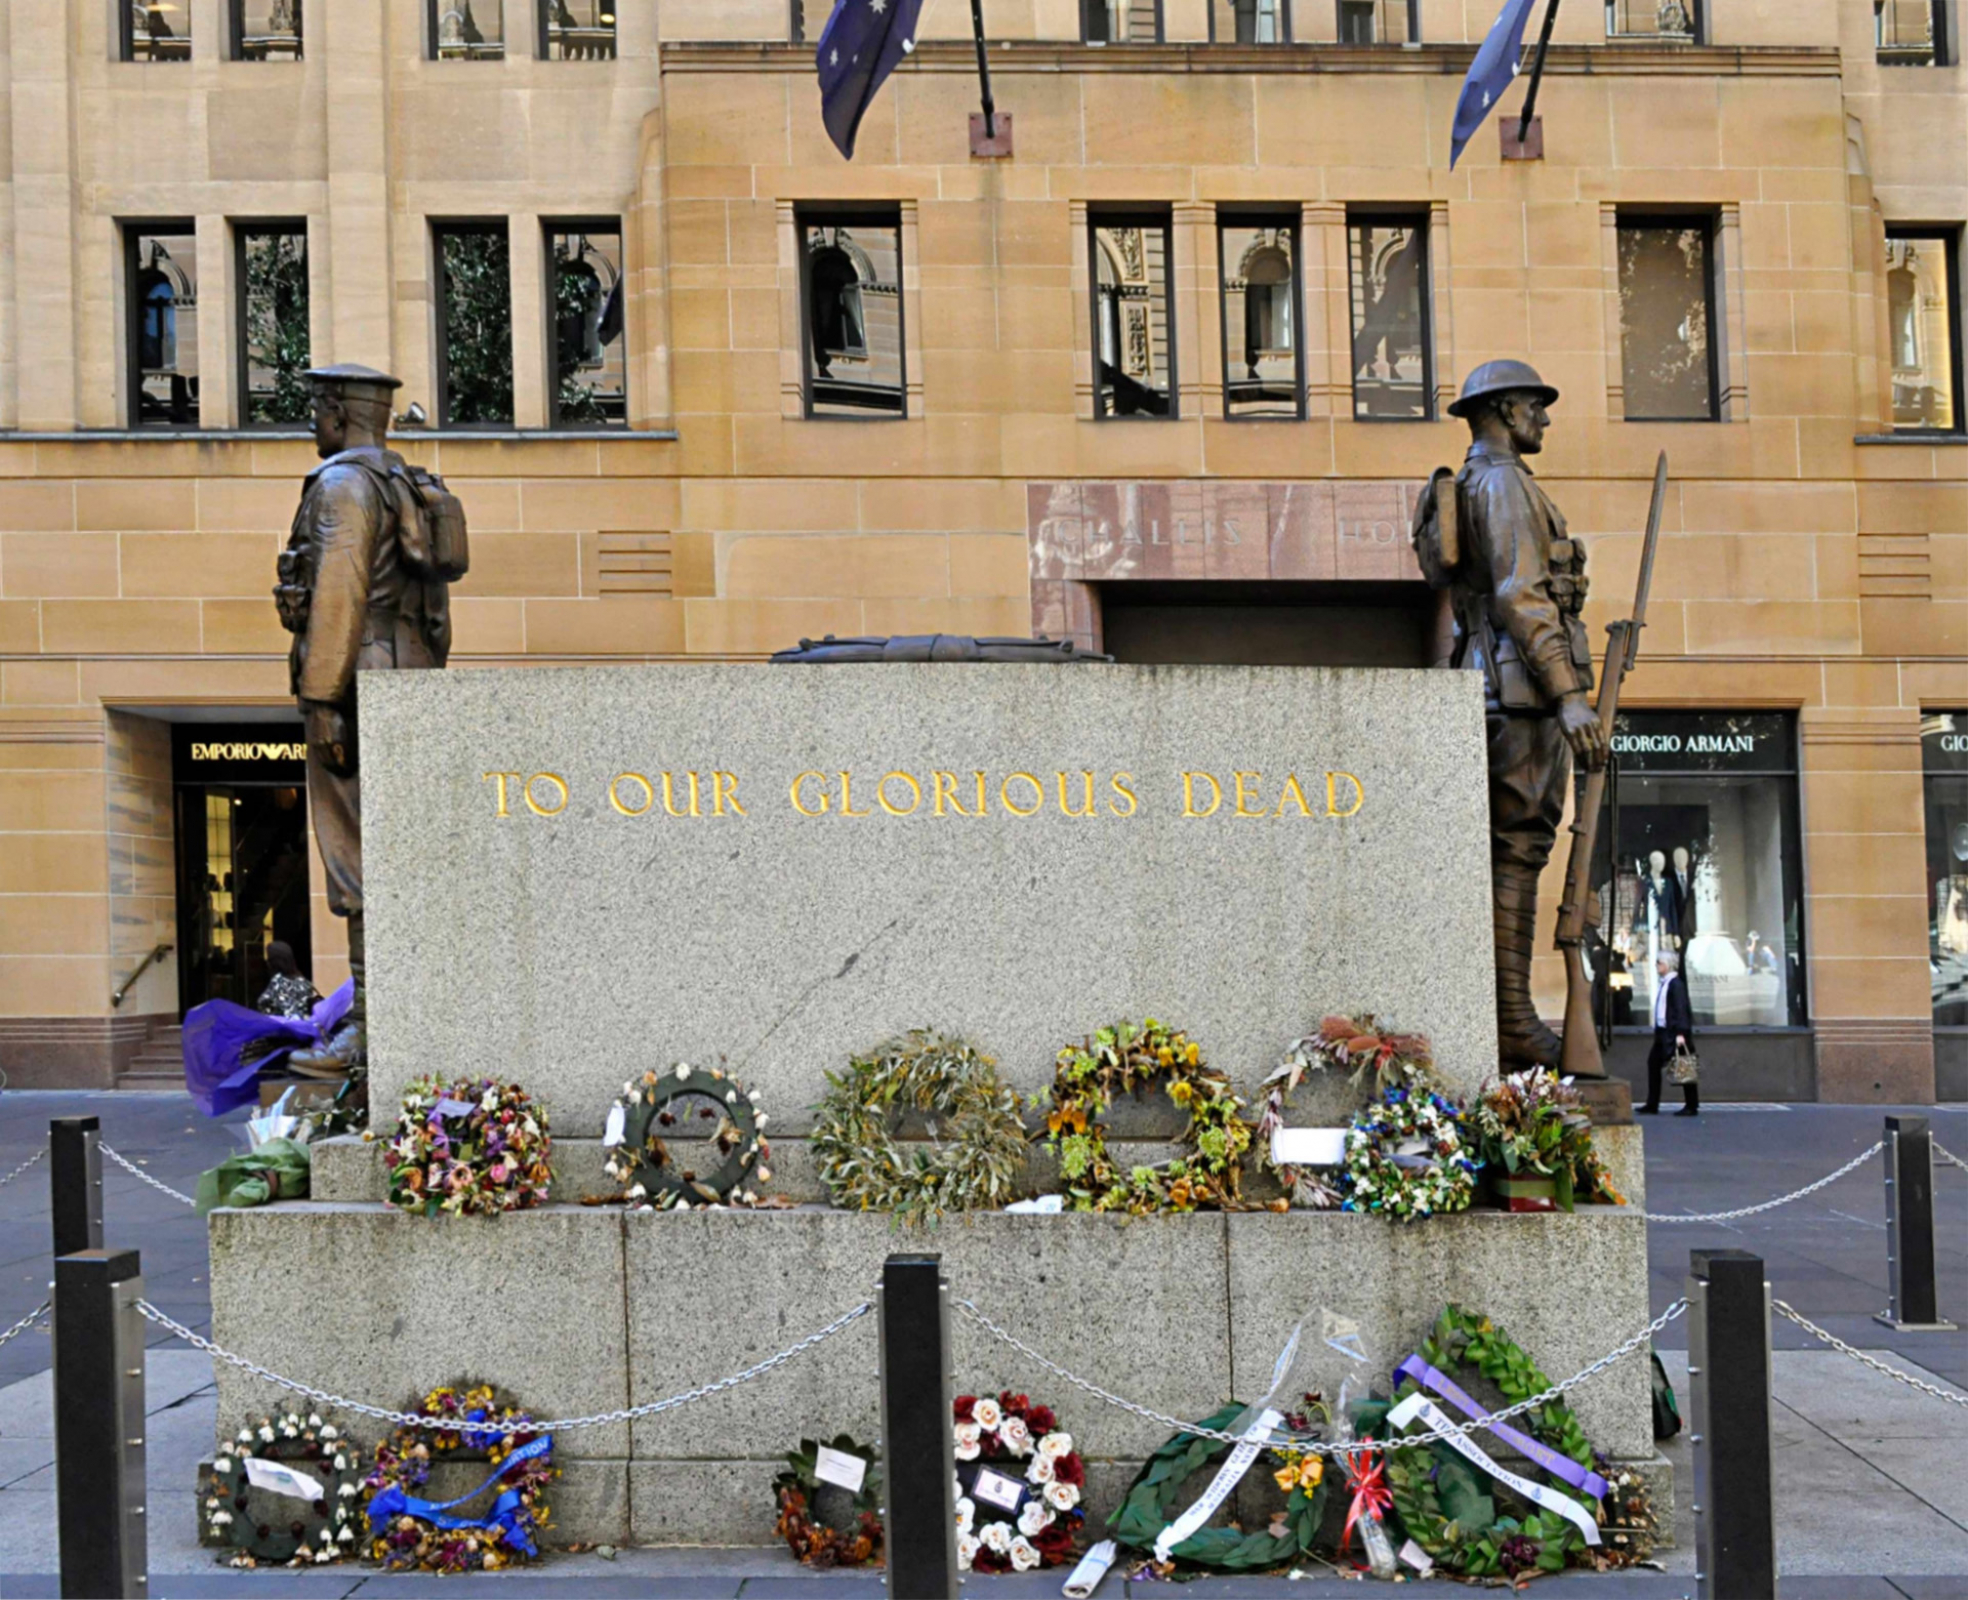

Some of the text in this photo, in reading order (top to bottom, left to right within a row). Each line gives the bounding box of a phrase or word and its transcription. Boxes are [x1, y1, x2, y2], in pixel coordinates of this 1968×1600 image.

[1057, 519, 1243, 546] CHALLIS
[191, 742, 262, 760] EMPORIO
[1610, 734, 1755, 752] GIORGIO ARMANI
[483, 771, 1364, 816] TO OUR GLORIOUS DEAD
[1455, 1435, 1525, 1489] ASSOCIATION
